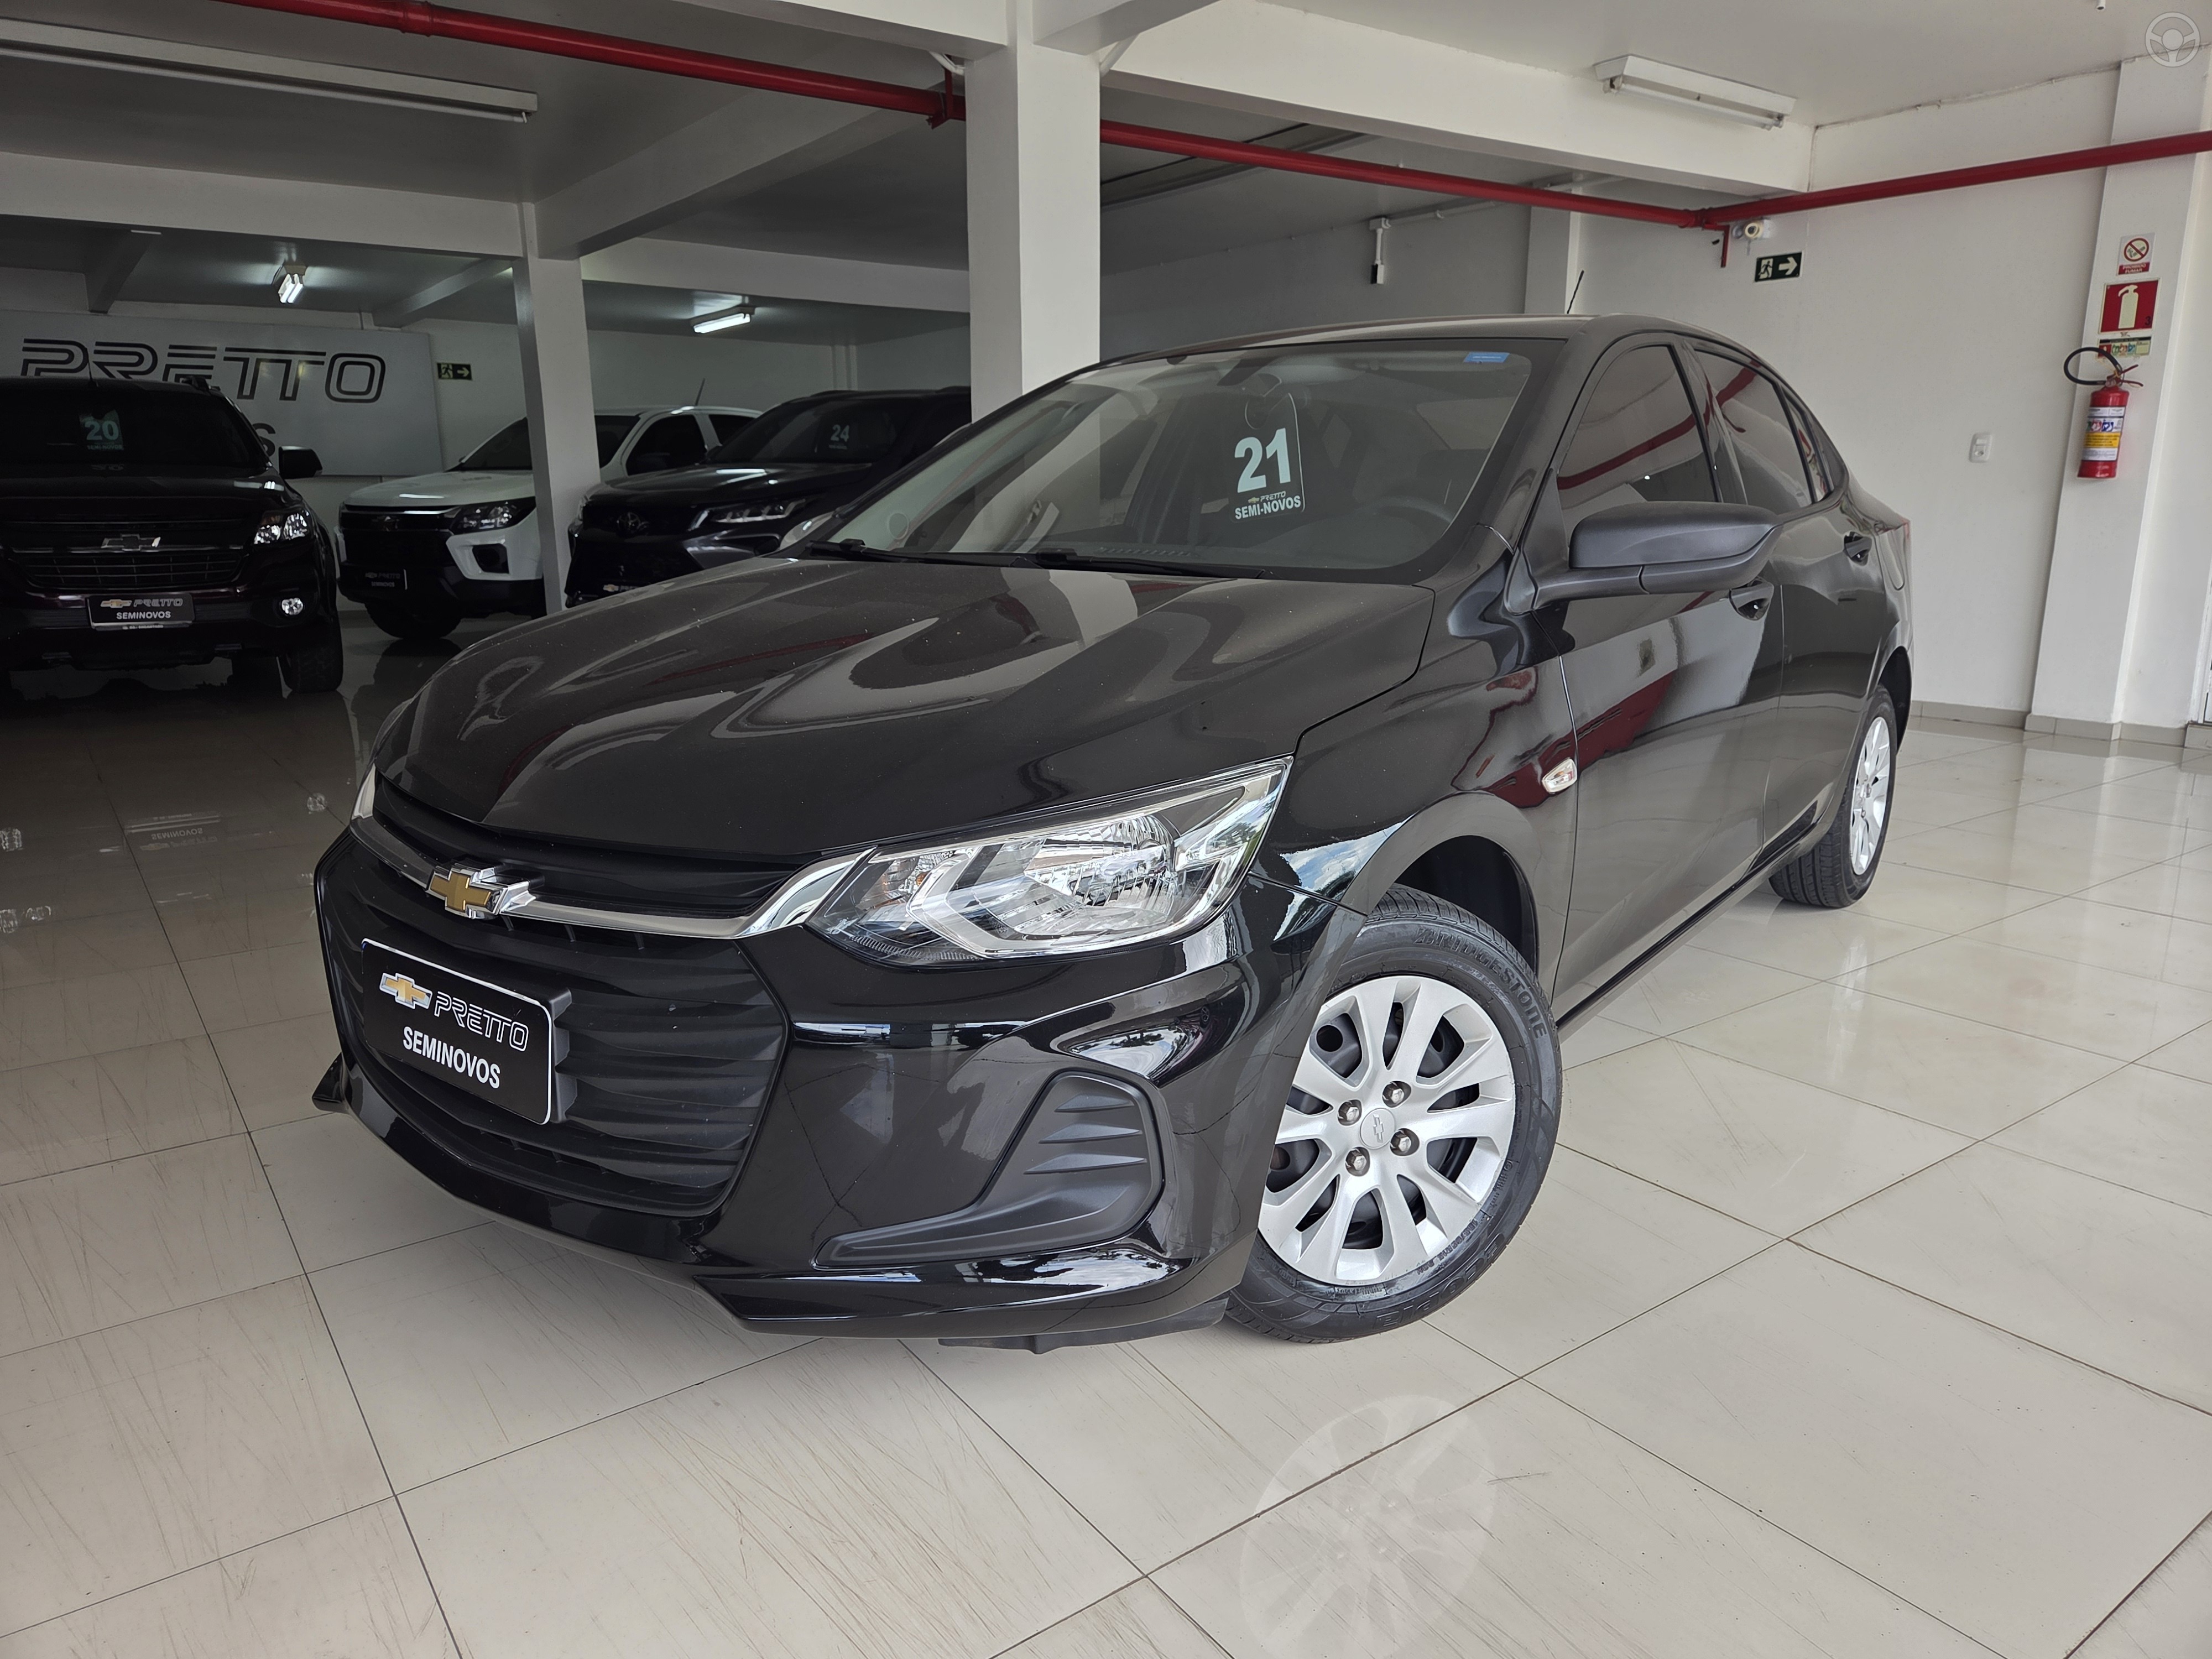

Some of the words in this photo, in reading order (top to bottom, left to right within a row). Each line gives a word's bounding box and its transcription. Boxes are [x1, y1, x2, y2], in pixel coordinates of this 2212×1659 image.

[2145, 316, 2151, 326] 3
[21, 338, 386, 404] PRETTO
[85, 420, 119, 441] 20
[830, 424, 850, 442] 24
[1234, 427, 1291, 493] 21
[1234, 495, 1301, 520] SEMI-NOVOS
[1260, 491, 1286, 502] PRETTO
[133, 598, 183, 607] PRETTO
[116, 611, 171, 619] SEMINOVOS
[1415, 927, 1548, 1039] BRIDGESTONE
[434, 990, 529, 1052] PRETTO
[403, 1026, 500, 1089] SEMINOVOS
